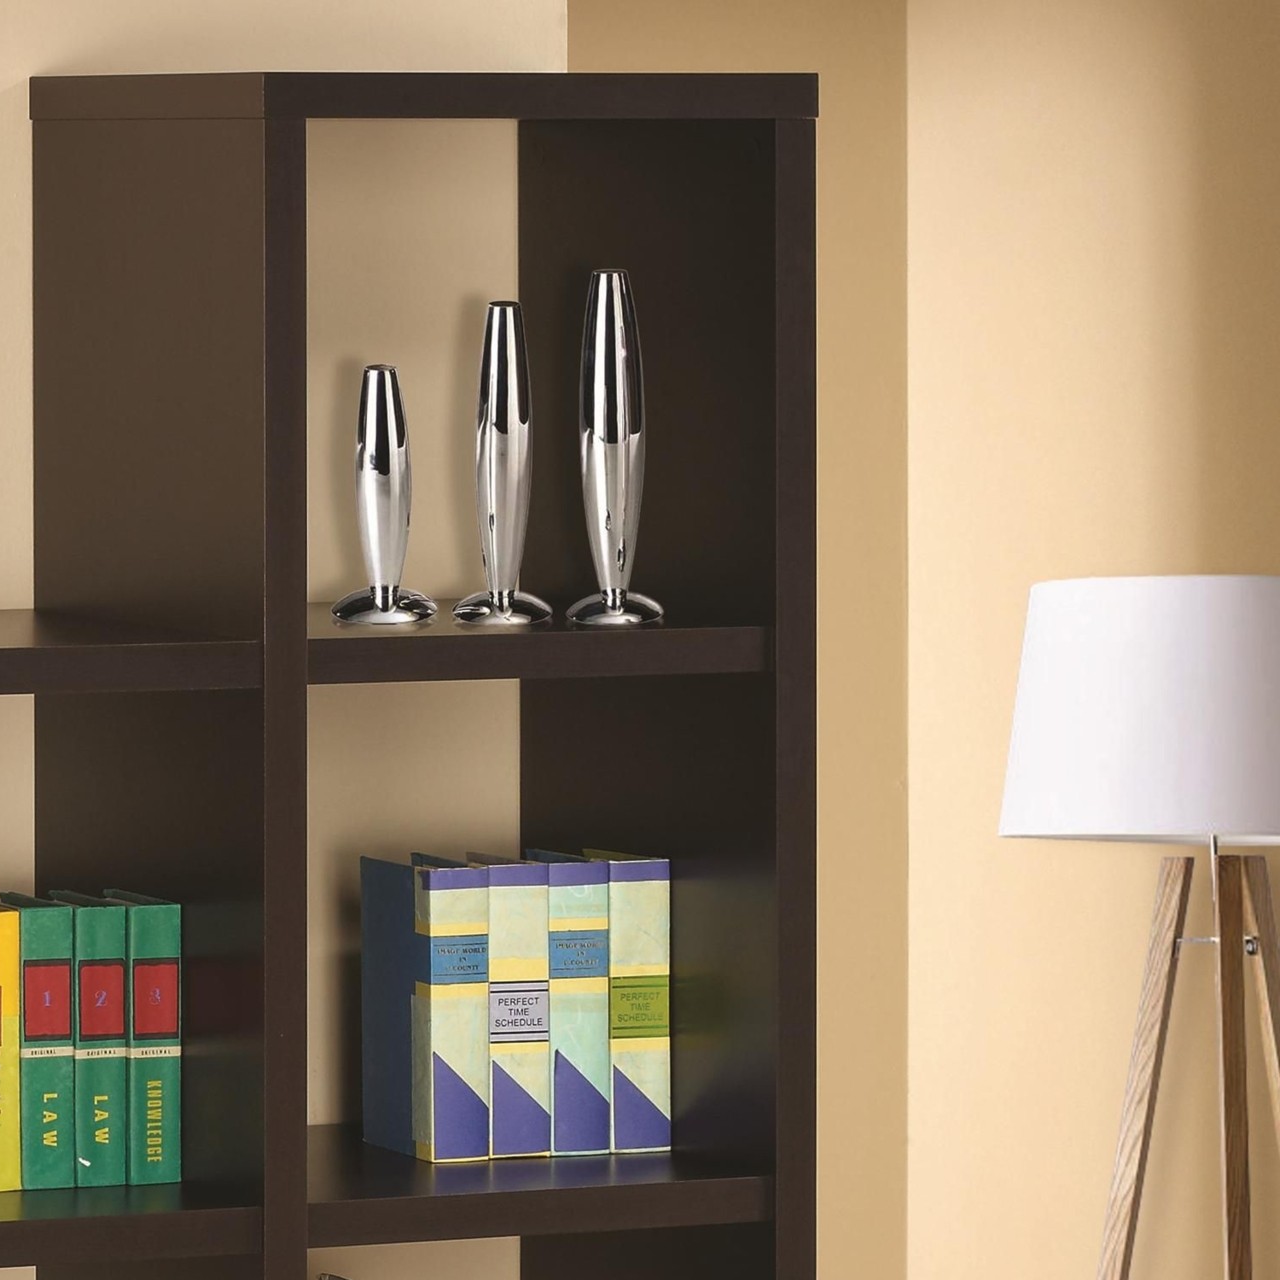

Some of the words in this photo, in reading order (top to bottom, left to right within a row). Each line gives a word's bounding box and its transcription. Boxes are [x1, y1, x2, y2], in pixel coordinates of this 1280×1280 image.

[43, 990, 51, 1007] 1
[94, 990, 108, 1007] 2
[150, 988, 161, 1005] 3
[498, 997, 540, 1006] PERFECT
[620, 992, 660, 1001] PERFECT
[508, 1008, 529, 1016] TIME
[631, 1003, 650, 1011] TIME
[495, 1018, 543, 1027] SCHEDULE
[617, 1013, 663, 1022] SCHEDULE
[43, 1092, 58, 1147] LAW
[94, 1095, 109, 1144] LAW
[147, 1080, 162, 1163] KNOWLEDGE
